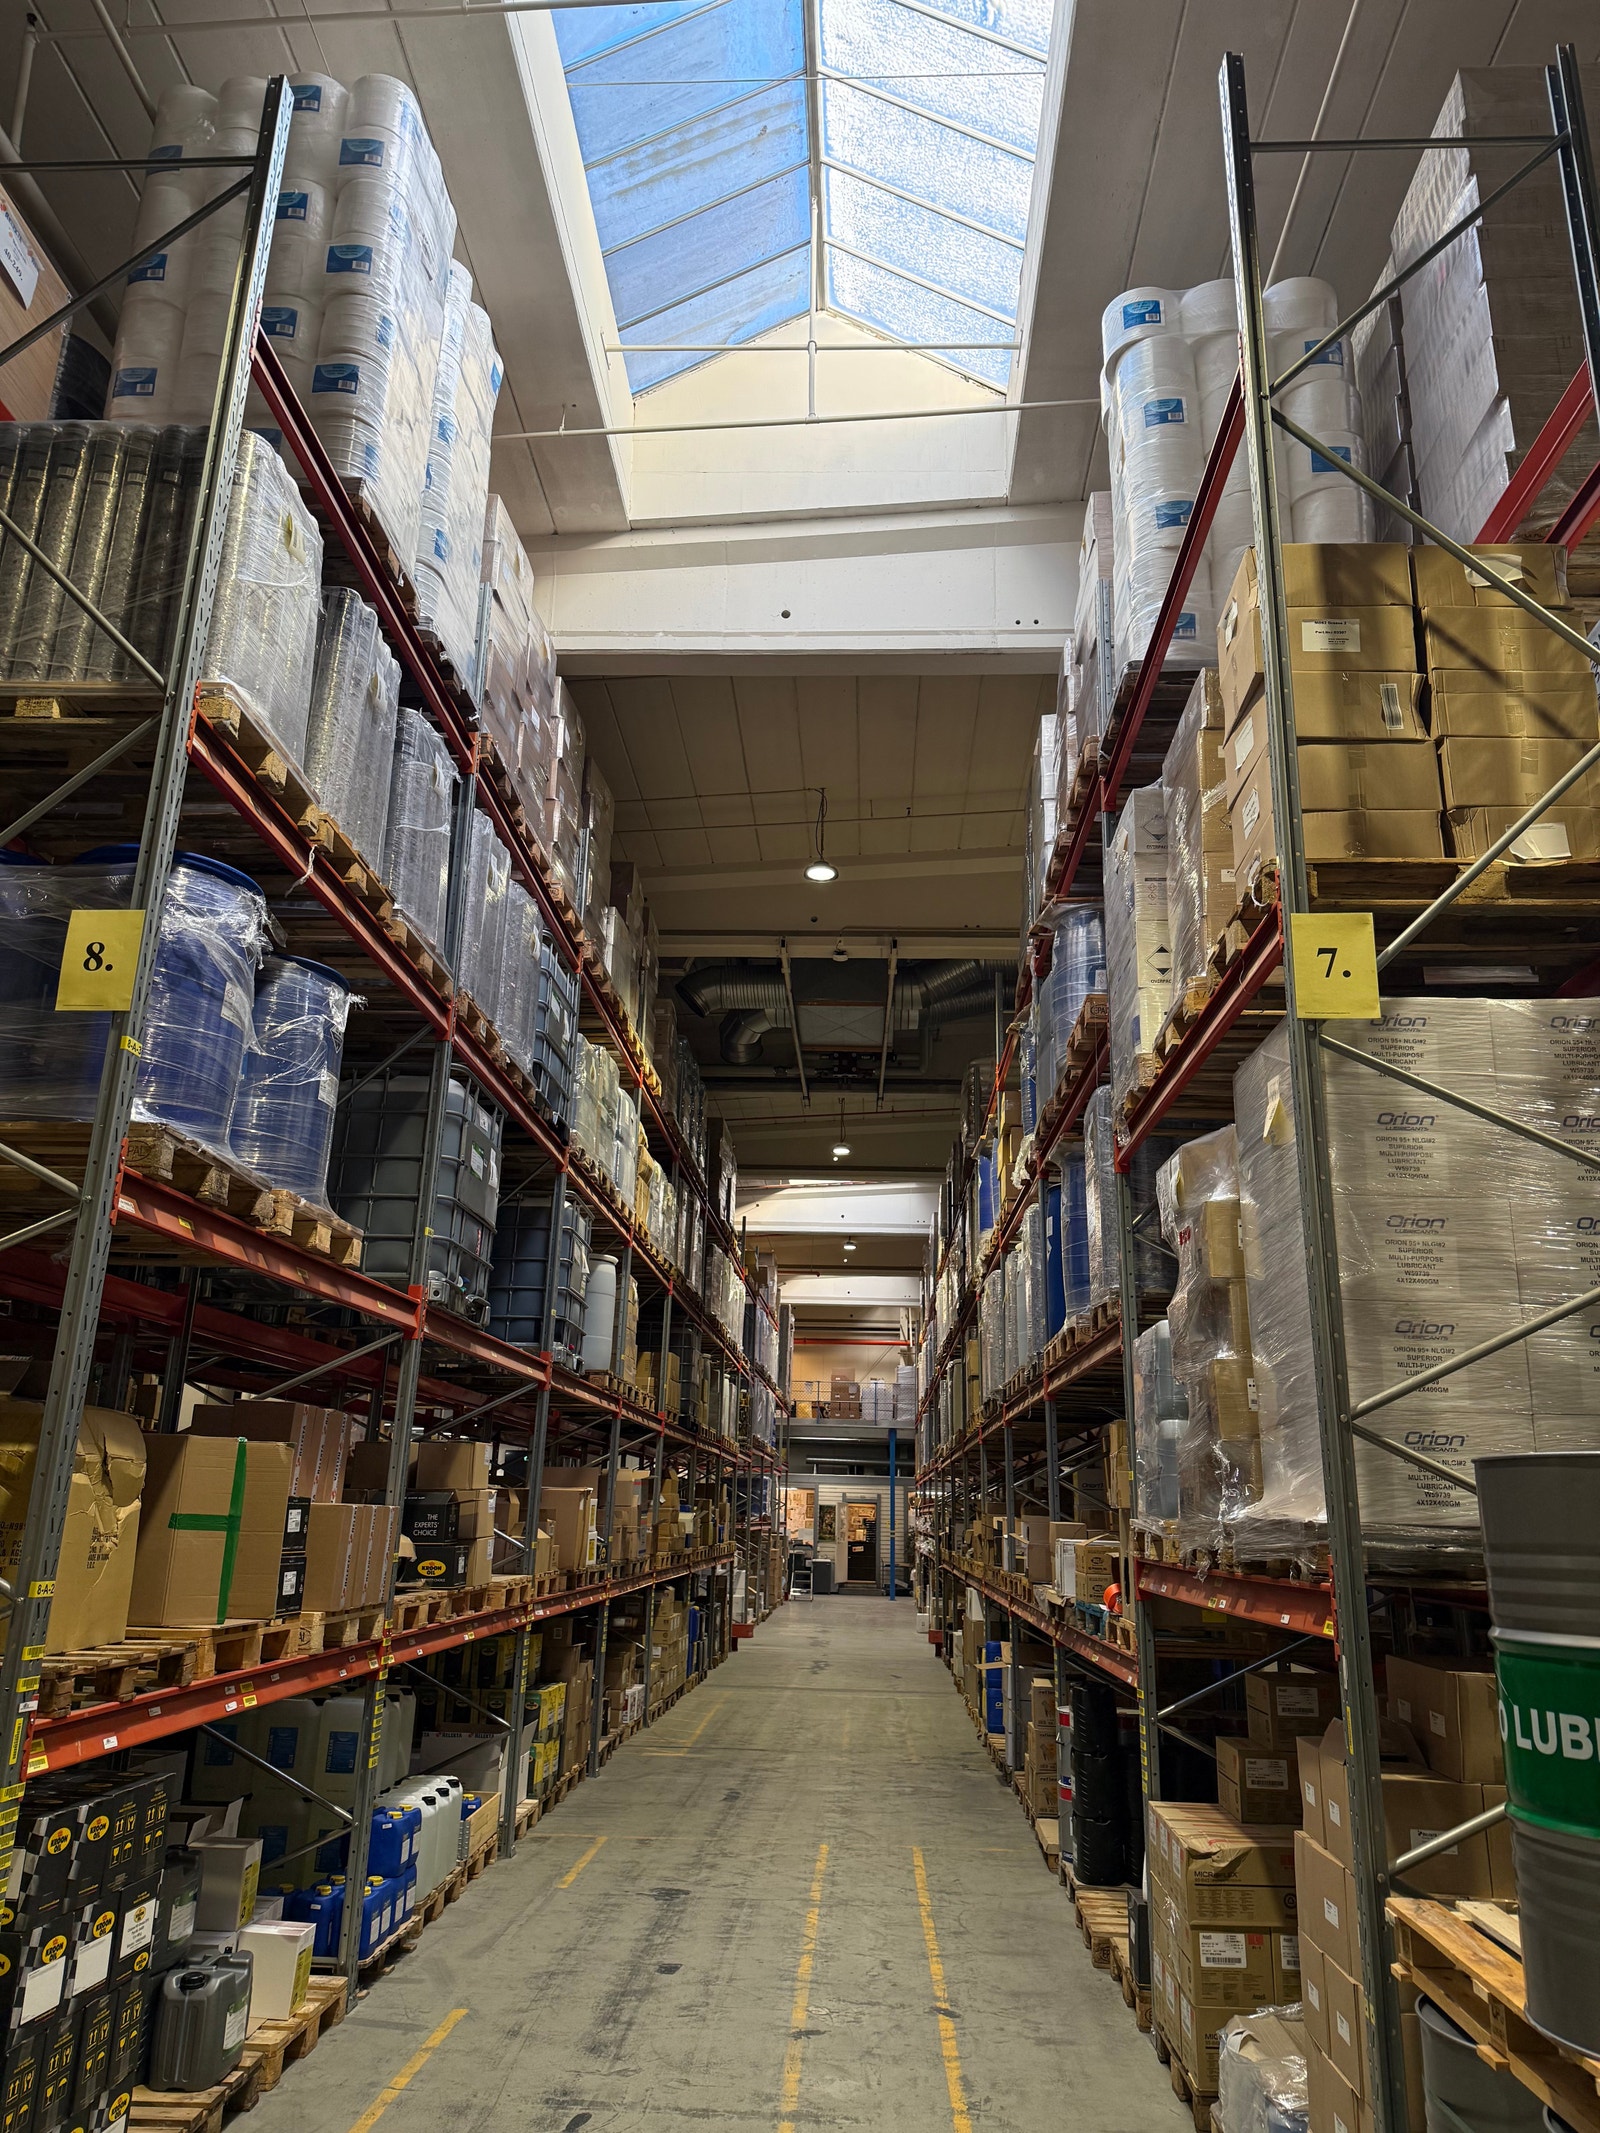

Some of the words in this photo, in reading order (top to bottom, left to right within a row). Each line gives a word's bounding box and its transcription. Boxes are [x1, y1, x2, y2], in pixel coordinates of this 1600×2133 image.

[83, 941, 113, 972] 8.
[1316, 947, 1352, 978] 7.
[1370, 1013, 1427, 1027] Orion
[1376, 1111, 1435, 1126] Orion
[1379, 1150, 1433, 1158] MULTI-PURPOSE
[1386, 1213, 1446, 1229] Orion
[1388, 1254, 1444, 1262] MULTI-PURPOSE
[1394, 1319, 1456, 1335] Orion
[1404, 1430, 1466, 1446] Orion
[1416, 1482, 1457, 1490] LUBRICANT
[427, 1513, 439, 1521] THE
[36, 1583, 56, 1595] 8-A-2
[90, 1821, 107, 1835] KROON
[50, 1834, 68, 1847] KROON
[92, 1831, 101, 1840] OIL
[53, 1844, 63, 1854] OIL
[95, 1918, 113, 1930] KROON
[46, 1943, 64, 1957] KROON
[111, 2101, 128, 2115] KROON
